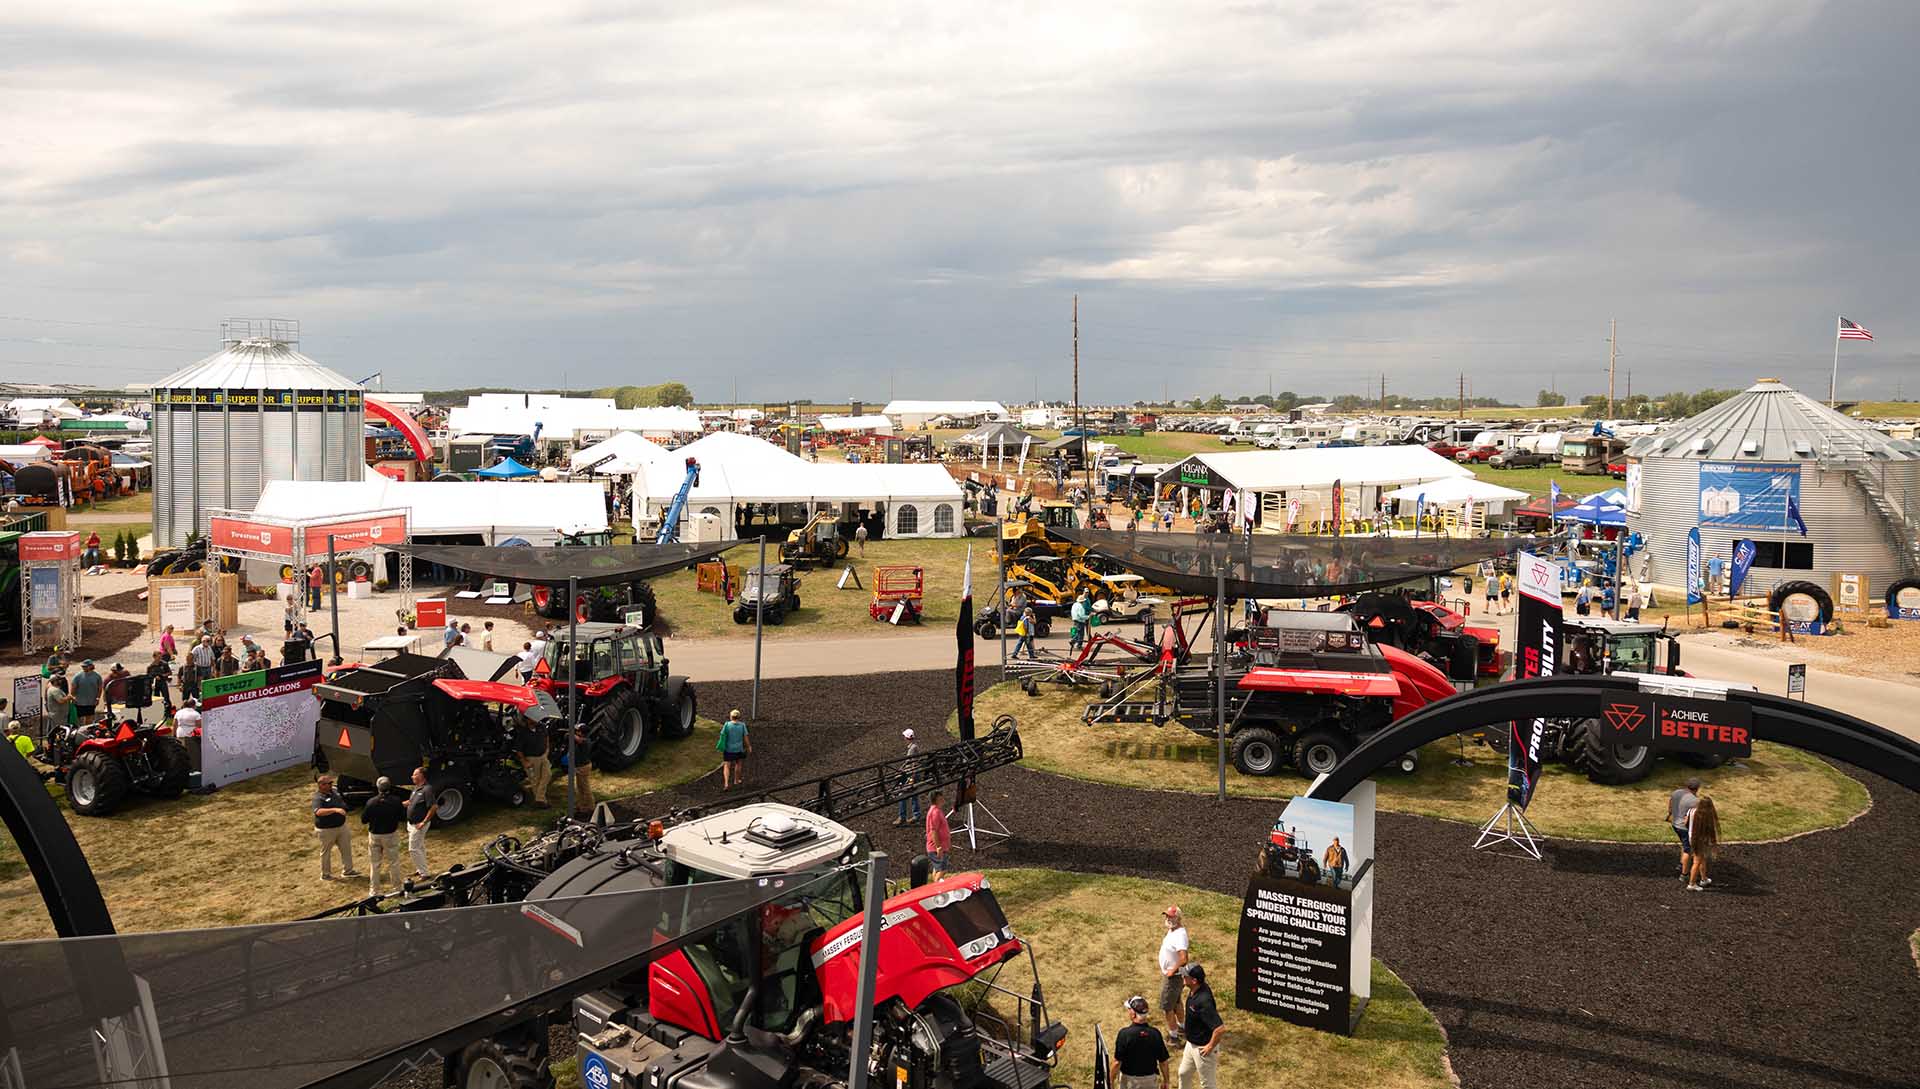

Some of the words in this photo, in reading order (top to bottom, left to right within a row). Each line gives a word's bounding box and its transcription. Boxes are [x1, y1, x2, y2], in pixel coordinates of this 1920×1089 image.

[170, 394, 207, 404] SUPEROR
[227, 394, 276, 404] SUPEROR
[296, 396, 334, 404] SUPEROR
[214, 679, 256, 694] FENDT
[228, 691, 257, 703] DEALER
[258, 681, 301, 697] LOCATIONS
[1670, 709, 1710, 722] ACHIEVE
[1661, 719, 1750, 745] BETTER
[1258, 889, 1295, 905] MASSEY
[1246, 907, 1289, 926] SPRAYING
[1289, 917, 1346, 936] CHALLENGES
[1255, 899, 1320, 920] UNDERSTANDS
[1321, 913, 1346, 926] YOUR
[822, 942, 843, 959] MASSEY
[843, 928, 865, 946] FERGUS
[1258, 926, 1269, 935] Are
[1269, 930, 1283, 938] your
[1283, 932, 1300, 941] fields
[1301, 936, 1322, 947] getting
[1258, 935, 1281, 945] sprayed
[1291, 941, 1308, 951] time?
[1258, 946, 1279, 957] Trouble
[1280, 952, 1294, 960] with
[1294, 955, 1337, 969] contamination
[1270, 958, 1284, 967] crop
[1284, 961, 1312, 972] damage?
[1257, 967, 1272, 976] Does
[1273, 971, 1287, 979] your
[1287, 973, 1315, 986] herbicide
[1315, 980, 1343, 992] coverage
[1257, 975, 1272, 984] keep
[1273, 979, 1286, 987] your
[1286, 982, 1304, 991] fields
[1304, 986, 1325, 996] clean?
[1257, 987, 1271, 996] How
[1271, 991, 1281, 999] are
[1282, 993, 1293, 1001] you
[1294, 996, 1330, 1010] maintaining
[1257, 996, 1279, 1005] correct
[1279, 1000, 1296, 1010] boom
[1296, 1004, 1319, 1015] height?
